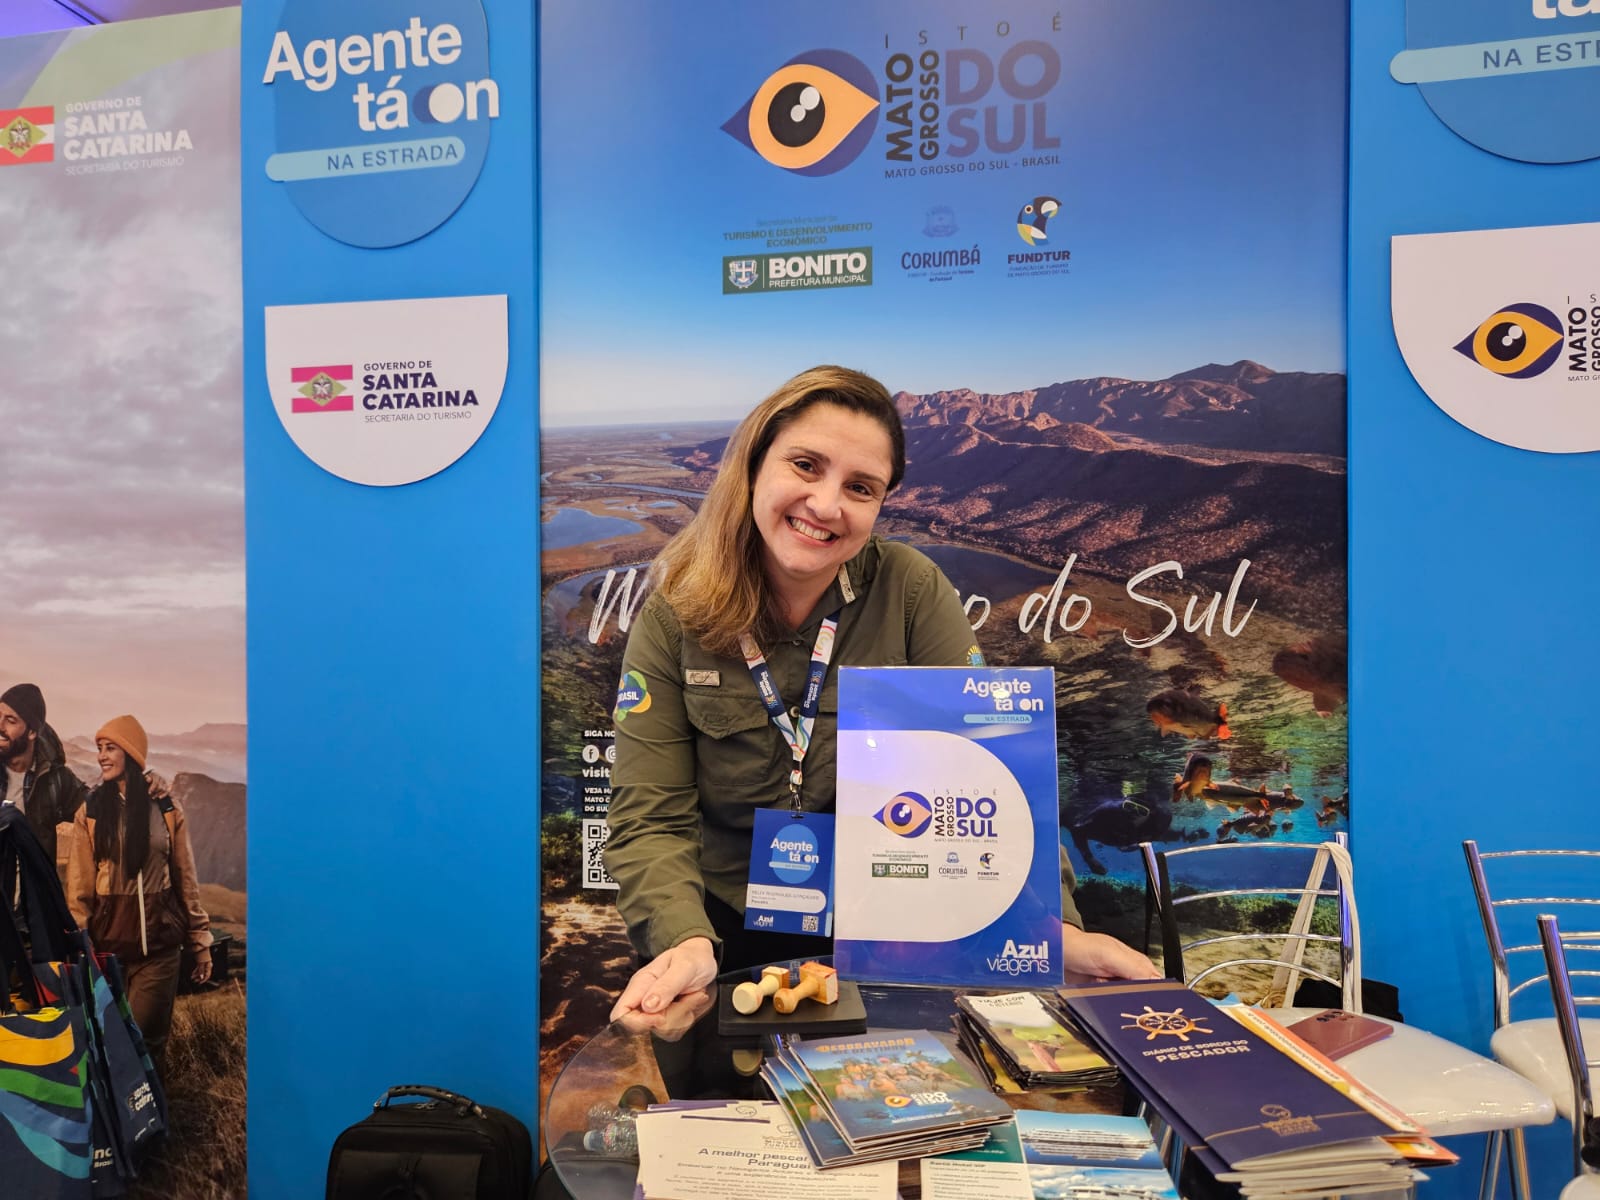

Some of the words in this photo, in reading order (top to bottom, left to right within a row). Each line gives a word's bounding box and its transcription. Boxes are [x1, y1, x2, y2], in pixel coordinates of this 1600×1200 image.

[262, 17, 462, 92] Agente
[1483, 48, 1522, 69] NA
[945, 40, 1061, 106] DO
[65, 98, 123, 113] GOVERNO
[126, 96, 142, 106] DE
[352, 75, 409, 132] tá
[885, 53, 914, 162] MATO
[919, 49, 940, 160] GROSSO
[64, 110, 148, 138] SANTA
[947, 101, 1061, 158] SUL
[63, 129, 193, 160] CATARINA
[142, 156, 184, 168] TURISMO
[327, 155, 354, 171] NA
[363, 144, 458, 168] ESTRADA
[884, 168, 916, 179] MATO
[920, 165, 965, 176] GROSSO
[969, 162, 985, 171] DO
[989, 160, 1010, 170] SUL
[1022, 155, 1061, 166] BRASIL
[722, 229, 767, 241] TURISMO
[775, 222, 873, 237] DESENVOLVIMENTO
[769, 252, 867, 279] BONITO
[901, 244, 981, 270] CORUMBÁ
[1008, 250, 1071, 264] FUNDTUR
[769, 277, 821, 288] PREFEITURA
[822, 275, 866, 285] MUNICIPAL
[1567, 307, 1587, 372] MATO
[364, 361, 415, 371] GOVERNO
[419, 360, 432, 369] DE
[363, 372, 438, 391] SANTA
[363, 390, 479, 410] CATARINA
[365, 413, 415, 423] SECRETARIA
[417, 413, 431, 421] DO
[433, 411, 472, 419] TURISMO
[1018, 553, 1092, 643] do
[1122, 558, 1258, 649] Sul
[962, 677, 1031, 698] Agente
[934, 796, 945, 836] MATO
[946, 796, 955, 837] GROSSO
[956, 797, 997, 819] DO
[956, 819, 998, 837] SUL
[770, 838, 813, 852] Agente
[789, 850, 801, 862] tá
[889, 865, 927, 874] BONITO
[1002, 939, 1049, 960] Azul
[986, 953, 1050, 976] viagens
[1142, 1047, 1178, 1057] DIÁRIO
[1195, 1041, 1232, 1050] BORDO
[1156, 1045, 1251, 1063] PESCADOR
[712, 1149, 761, 1159] melhor
[747, 1158, 811, 1170] Paraguai
